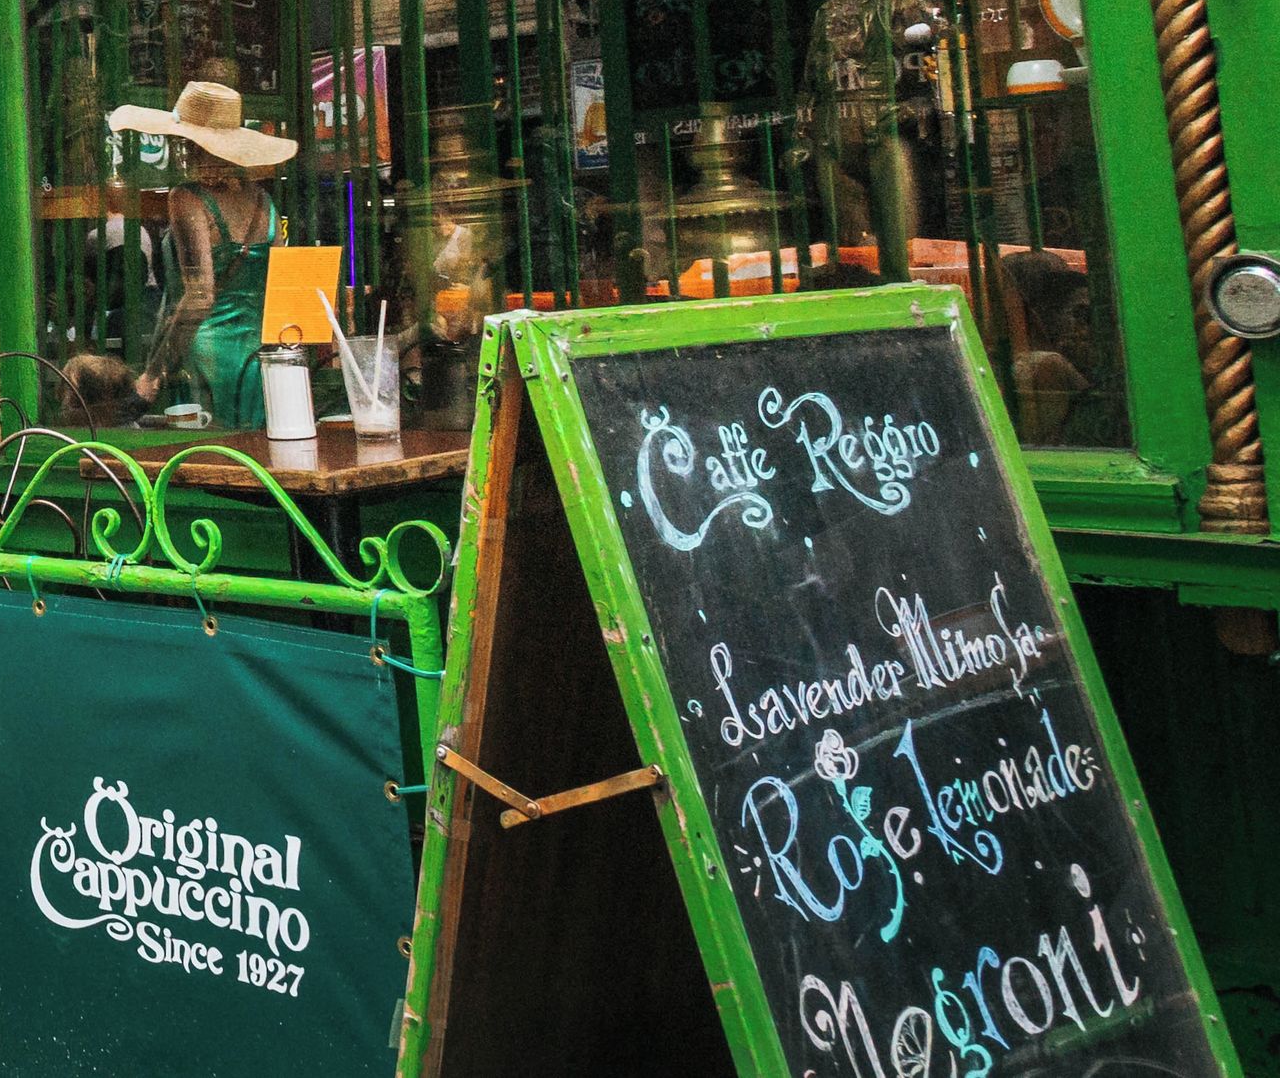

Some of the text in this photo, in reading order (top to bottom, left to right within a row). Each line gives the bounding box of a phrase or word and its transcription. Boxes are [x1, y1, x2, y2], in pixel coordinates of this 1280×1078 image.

[639, 387, 940, 551] Caffe Reggio
[709, 642, 906, 748] Lavender
[30, 816, 310, 957] Cappuccino
[84, 776, 301, 893] Original
[137, 921, 305, 997] Since 1927
